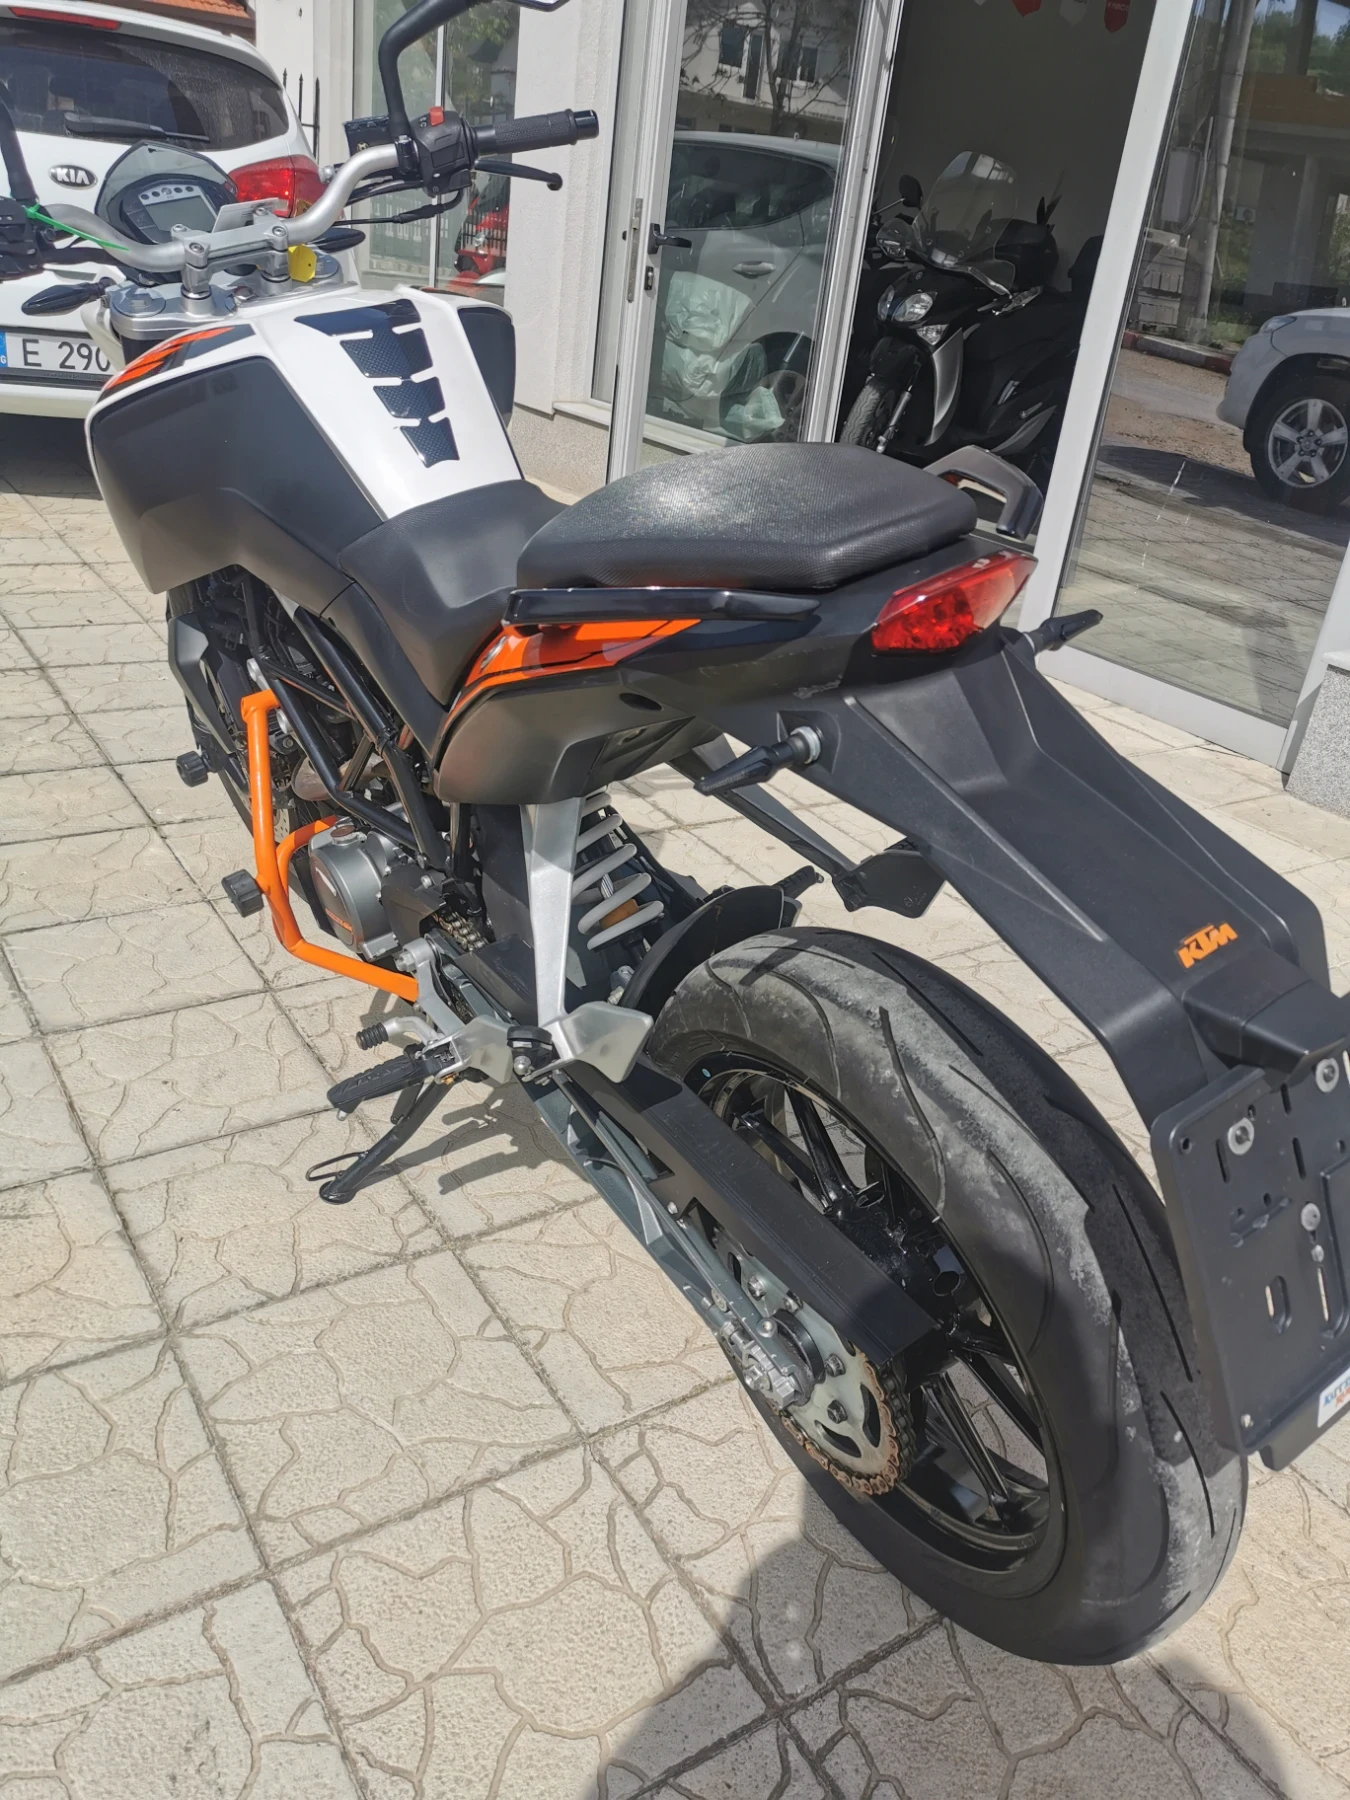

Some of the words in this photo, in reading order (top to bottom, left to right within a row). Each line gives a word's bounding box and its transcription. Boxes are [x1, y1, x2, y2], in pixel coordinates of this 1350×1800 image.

[56, 167, 90, 185] KIA
[22, 338, 42, 367] E
[1178, 922, 1238, 969] KTM
